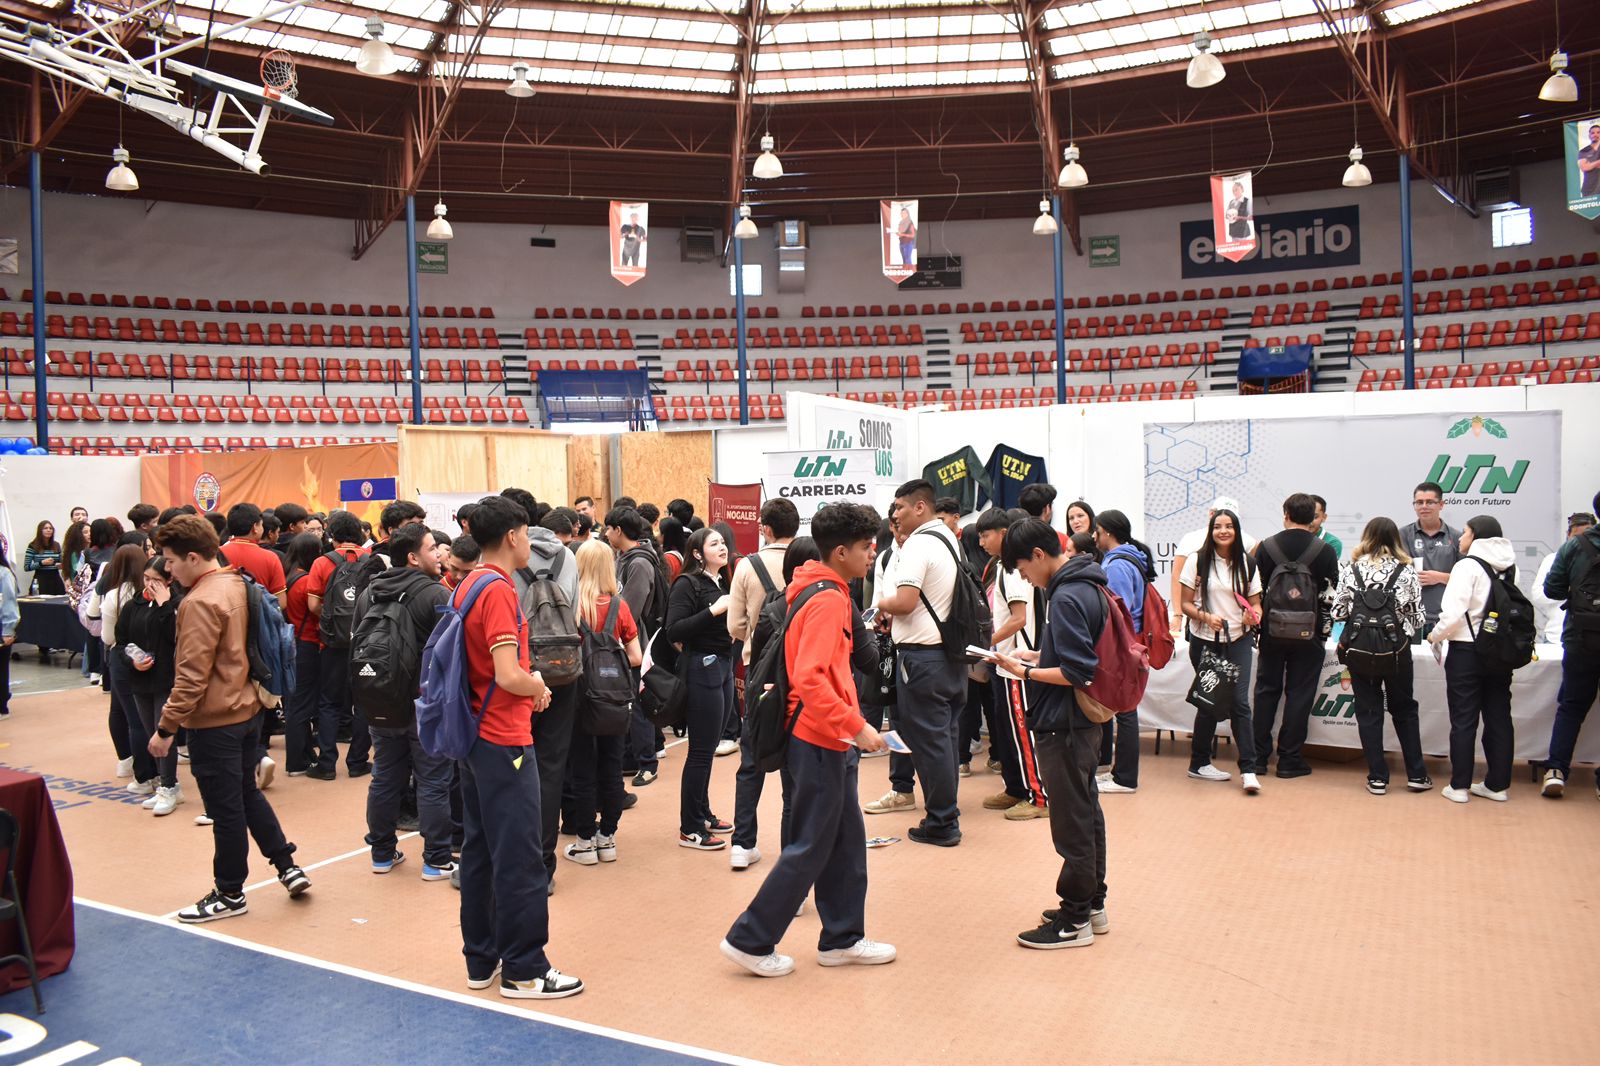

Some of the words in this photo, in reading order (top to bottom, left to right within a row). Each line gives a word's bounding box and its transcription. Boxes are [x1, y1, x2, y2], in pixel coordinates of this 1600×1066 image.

[1569, 201, 1600, 211] ODONTOL
[1188, 235, 1224, 264] e
[859, 418, 893, 450] SOMOS
[793, 455, 848, 478] UTN
[937, 458, 966, 480] UTN
[1002, 454, 1032, 477] UTN
[1425, 454, 1531, 494] UTN
[778, 483, 867, 498] CARRERAS
[1443, 496, 1462, 505] ción
[1464, 498, 1480, 506] con
[1482, 497, 1511, 506] Futuro
[726, 510, 757, 521] NOGALES
